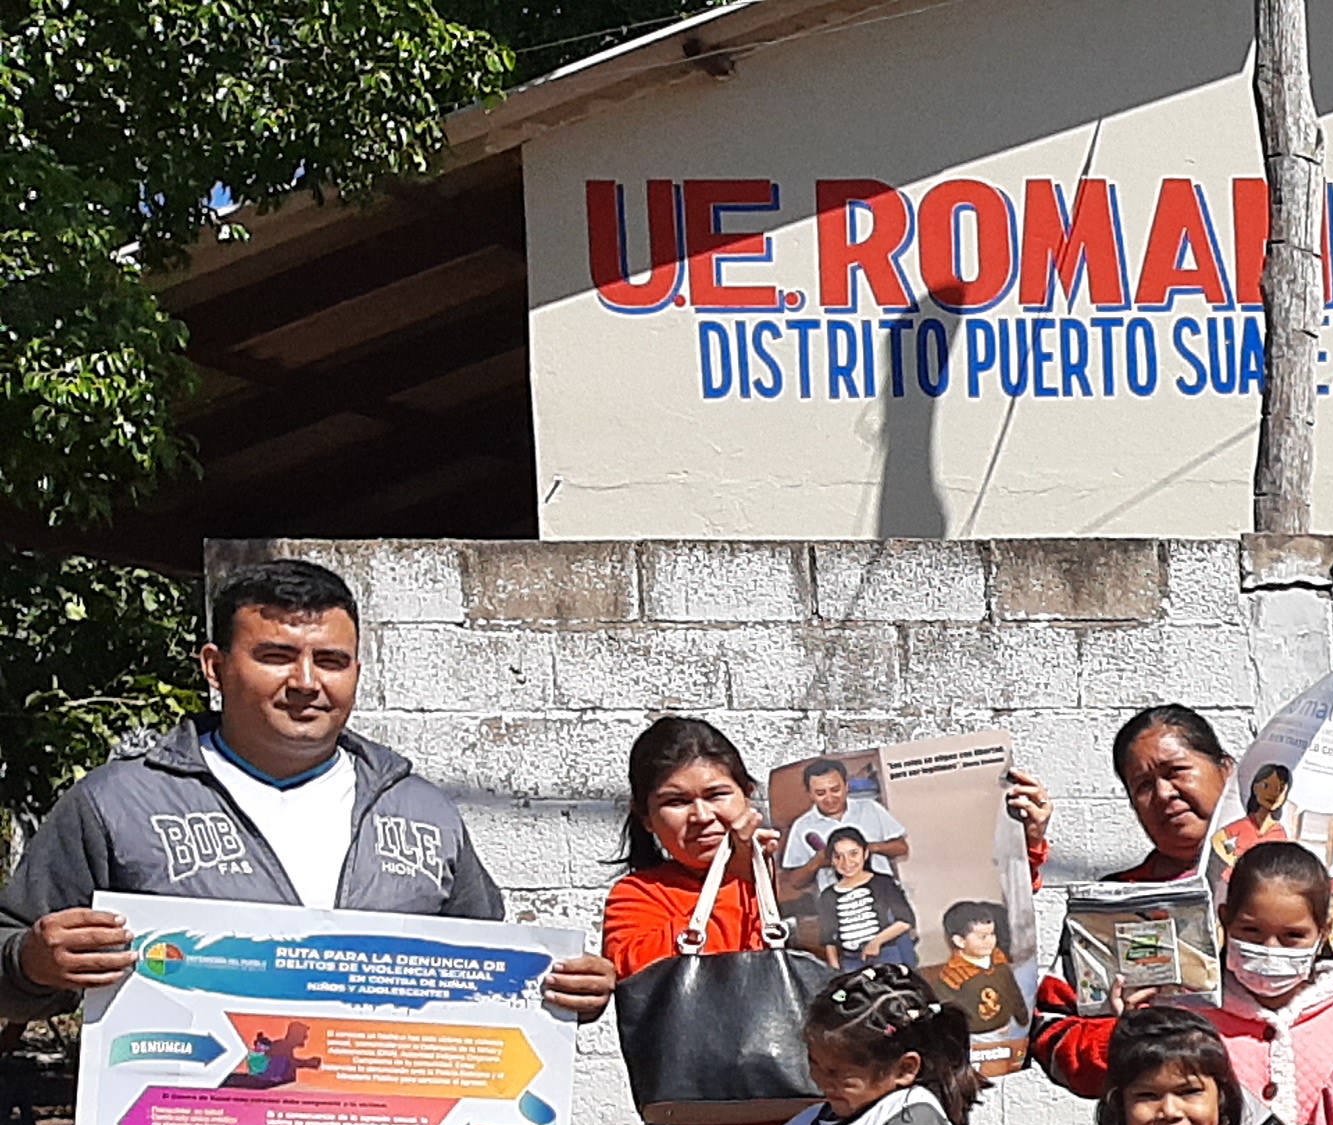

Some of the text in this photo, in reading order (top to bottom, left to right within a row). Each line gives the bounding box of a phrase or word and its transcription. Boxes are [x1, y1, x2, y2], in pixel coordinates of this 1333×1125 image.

[698, 316, 948, 400] DISTRITO
[966, 314, 1156, 398] PUERTO
[150, 811, 246, 884] BOB
[274, 957, 494, 982] DELITOS DE VIOLENCIA SEXUAL
[275, 946, 507, 973] RUTA PARA LA DENUNCIA DE
[347, 984, 357, 995] Y
[358, 984, 451, 999] ADOLESCENTES
[348, 973, 366, 984] EN
[368, 975, 417, 988] CONTRA
[418, 978, 437, 989] DE
[130, 1041, 193, 1056] DENUNCIA
